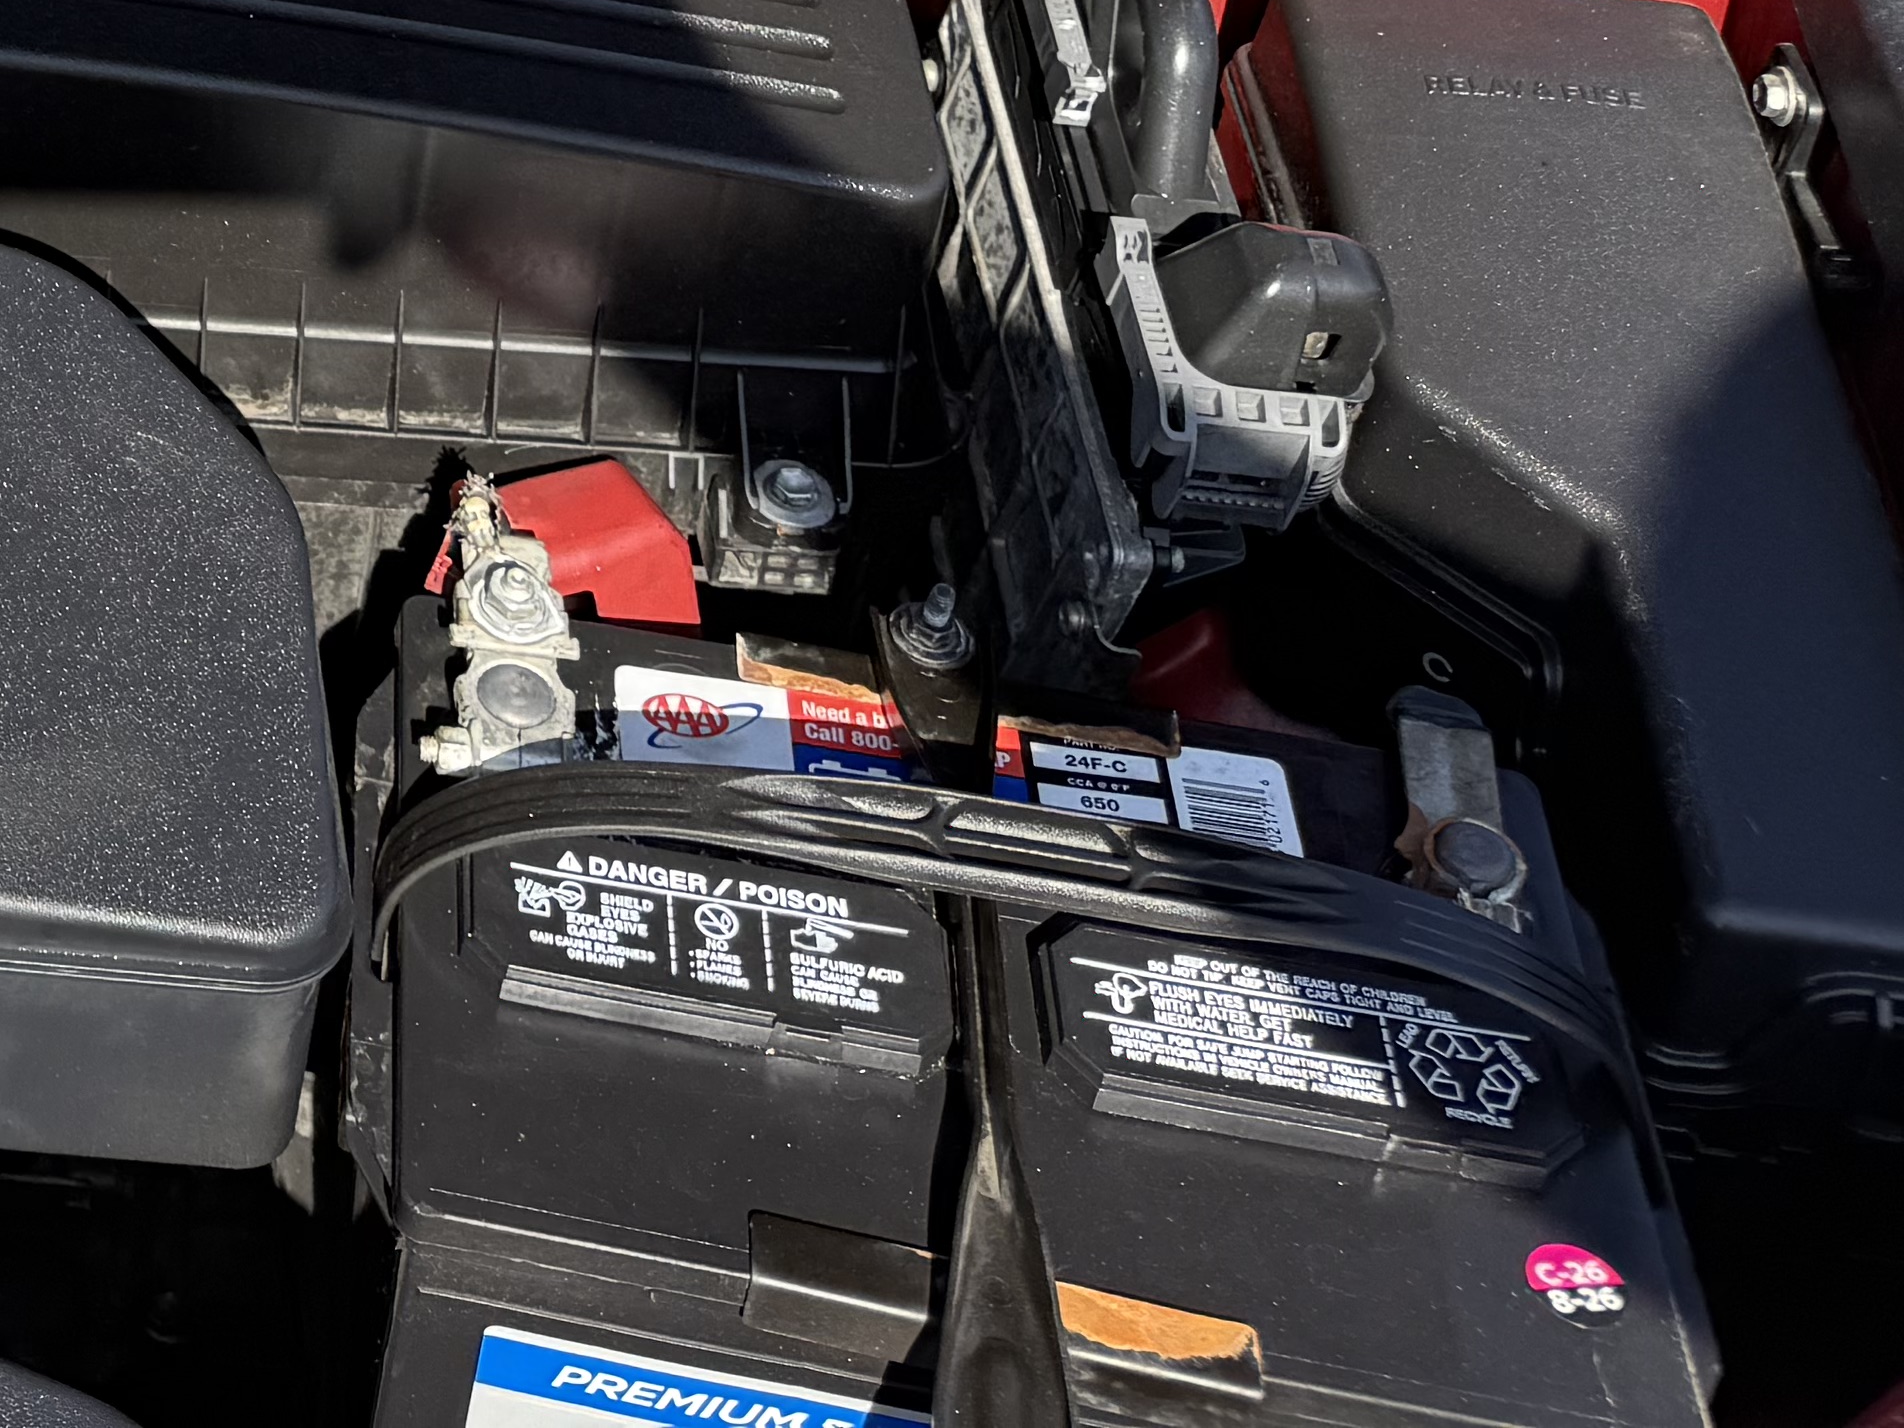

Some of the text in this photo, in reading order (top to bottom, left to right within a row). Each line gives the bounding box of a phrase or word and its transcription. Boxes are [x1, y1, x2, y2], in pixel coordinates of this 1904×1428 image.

[1424, 74, 1647, 110] RELAY & FUSE
[801, 700, 850, 724] Need
[854, 711, 867, 725] a
[804, 722, 843, 743] Call
[1064, 754, 1127, 773] 24F-C
[1067, 777, 1094, 788] CCA
[1080, 795, 1120, 812] 650
[588, 855, 707, 894] DANGER
[739, 881, 849, 918] POISON
[600, 892, 654, 913] SHIELD
[601, 904, 640, 922] EYES
[529, 929, 553, 945] CAN
[566, 911, 649, 938] EXPLOSIVE
[566, 924, 619, 944] GASES
[705, 938, 729, 951] NO
[695, 949, 742, 966] SPARKS
[695, 960, 742, 977] FLAMES
[790, 952, 905, 984] SULFURIC ACID
[791, 965, 860, 988] CAN CAUSE
[1147, 960, 1169, 974] DO
[1171, 964, 1198, 980] NOT
[1231, 975, 1266, 991] KEEP
[1267, 981, 1302, 996] VENT
[1305, 988, 1340, 1003] CAPS
[1344, 994, 1382, 1010] TIGHT
[1386, 1001, 1415, 1016] AND
[1209, 960, 1239, 975] OUT
[1241, 965, 1261, 979] OF
[1263, 969, 1290, 984] THE
[1293, 975, 1336, 992] REACH
[1340, 983, 1358, 995] OF
[1149, 981, 1354, 1029] FLUSH EYES IMMEDIATELY
[1150, 995, 1193, 1015] WITH
[1259, 1014, 1293, 1032] GET
[1153, 1010, 1314, 1049] MEDICAL HELP FAST
[1396, 1023, 1421, 1049] LEAD
[1112, 1035, 1202, 1061] INSTRUCTIONS
[1219, 1054, 1270, 1073] VEHICLE
[1126, 1048, 1152, 1063] NOT
[1167, 1034, 1194, 1049] FOR
[1196, 1039, 1229, 1055] SAFE
[1230, 1046, 1265, 1061] JUMP
[1267, 1051, 1329, 1072] STARTING
[1331, 1062, 1385, 1082] FOLLOW
[1444, 1106, 1515, 1130] RECYCLE
[1534, 1259, 1609, 1287] C-26
[1547, 1286, 1625, 1314] 8-26
[550, 1363, 809, 1428] PREMIUM
